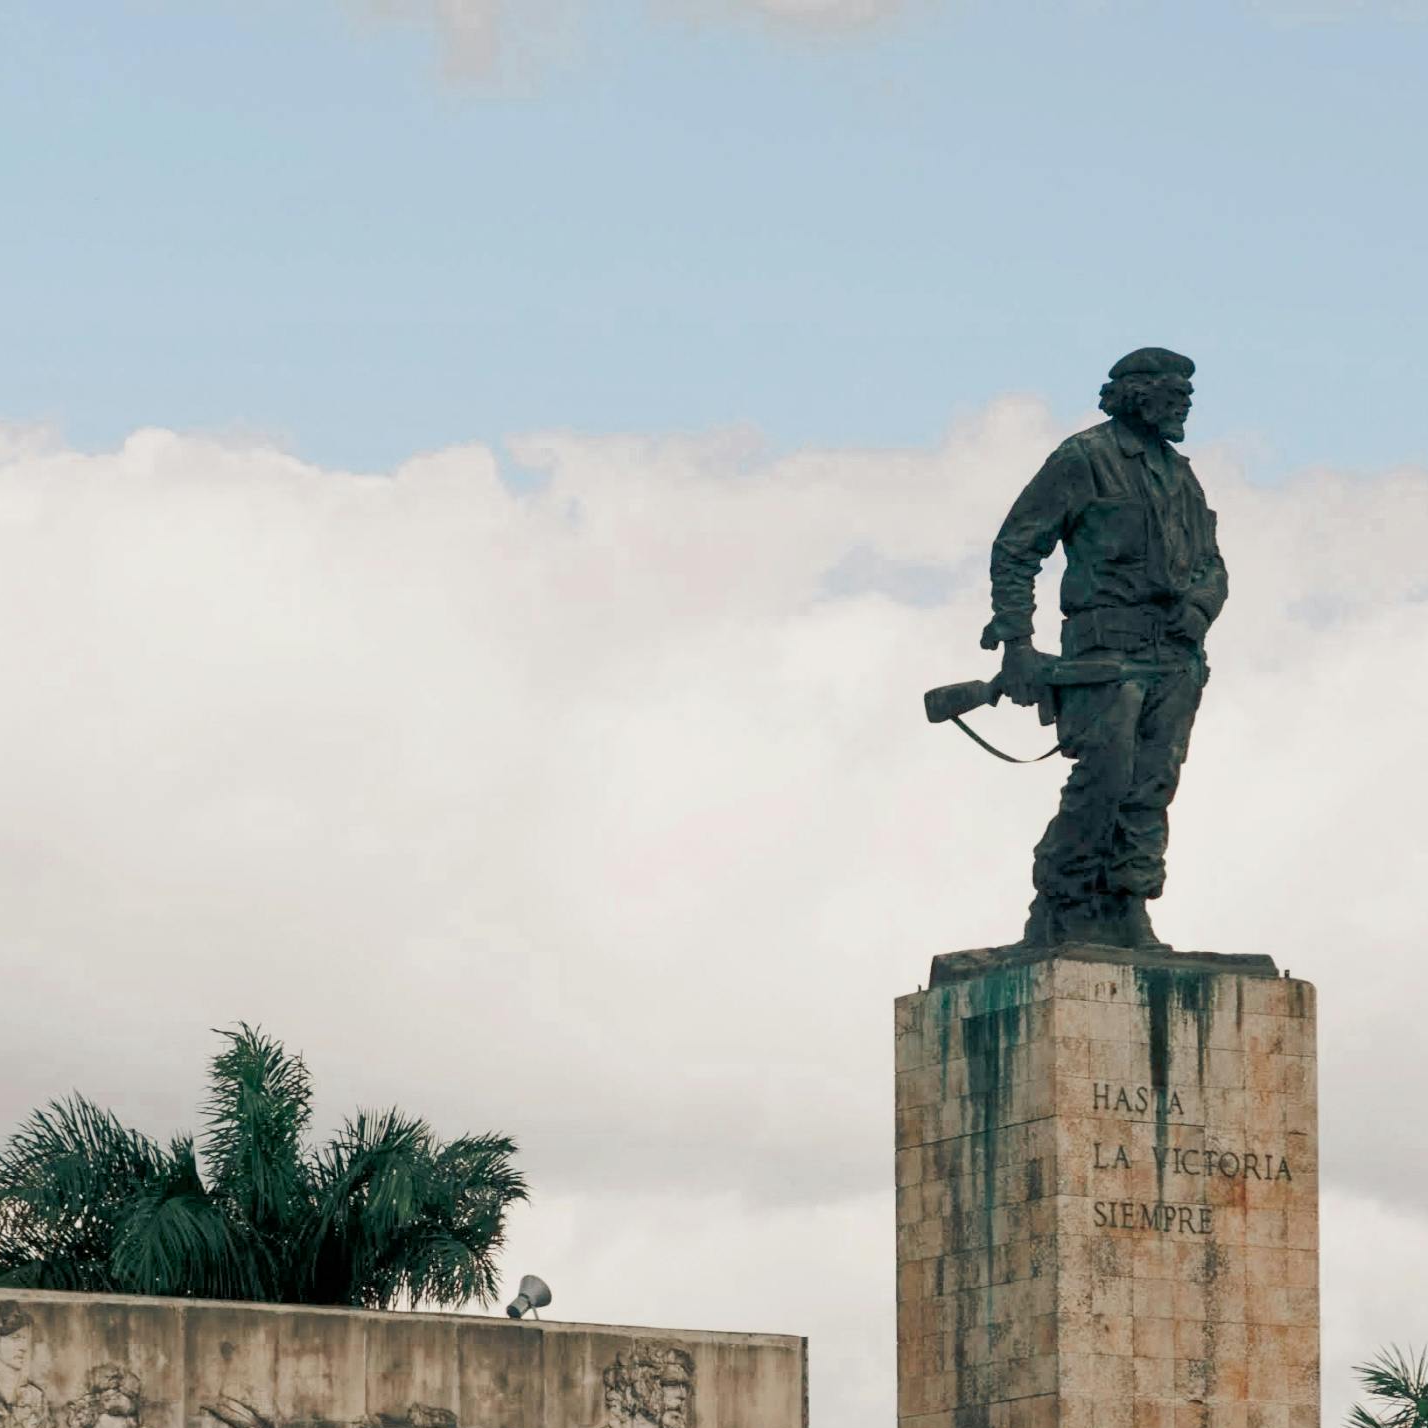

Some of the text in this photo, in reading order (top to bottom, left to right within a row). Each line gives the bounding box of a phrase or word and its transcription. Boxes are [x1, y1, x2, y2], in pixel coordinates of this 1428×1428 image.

[1092, 1082, 1184, 1116] HASTA
[1092, 1142, 1293, 1182] LA VICTORIA
[1093, 1201, 1213, 1235] SIEMPRE
